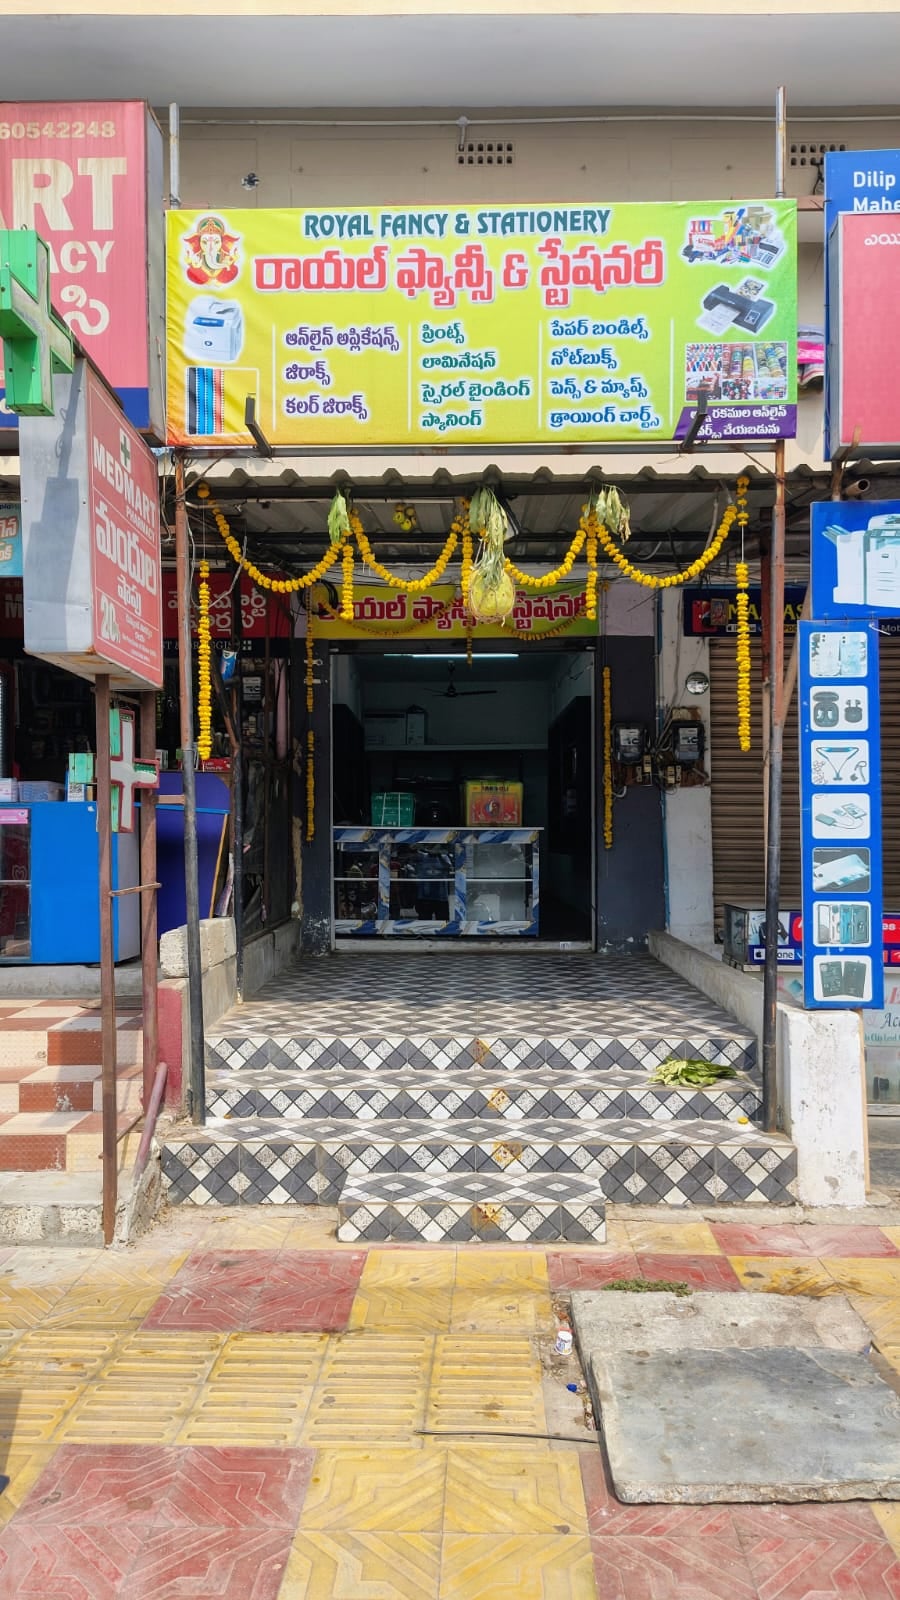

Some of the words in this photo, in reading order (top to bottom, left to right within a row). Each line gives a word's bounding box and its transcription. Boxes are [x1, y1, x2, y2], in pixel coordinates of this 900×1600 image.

[853, 170, 896, 191] Dilip
[0, 157, 127, 231] RT
[305, 214, 374, 238] ROYAL
[380, 213, 449, 238] FANCY
[455, 213, 469, 234] &
[477, 209, 611, 236] STATIONERY
[255, 246, 388, 290] రాయల్
[396, 244, 493, 306] ఫ్యాన్సీ
[503, 253, 529, 287] &
[538, 238, 664, 306] స్టేషనరీ
[336, 326, 400, 352] అప్లికేషన్స్
[421, 322, 465, 344] ప్రింట్స్
[551, 319, 589, 336] పేపర్
[592, 318, 648, 339] బండిల్స్
[285, 360, 331, 386] జిరాక్స్
[422, 351, 496, 370] లామినేషన్
[421, 380, 466, 404] స్పైరల్
[468, 379, 531, 402] బైండింగ్
[550, 378, 582, 399] పెన్స్
[584, 380, 598, 394] &
[601, 376, 648, 399] మ్యాప్స్
[285, 394, 320, 414] కలర్
[322, 394, 368, 420] జిరాక్స్
[550, 406, 616, 428] డ్రాయింగ్
[620, 405, 660, 429] చార్ట్స్
[422, 409, 482, 431] స్కానింగ్
[93, 435, 156, 529] MEDMART
